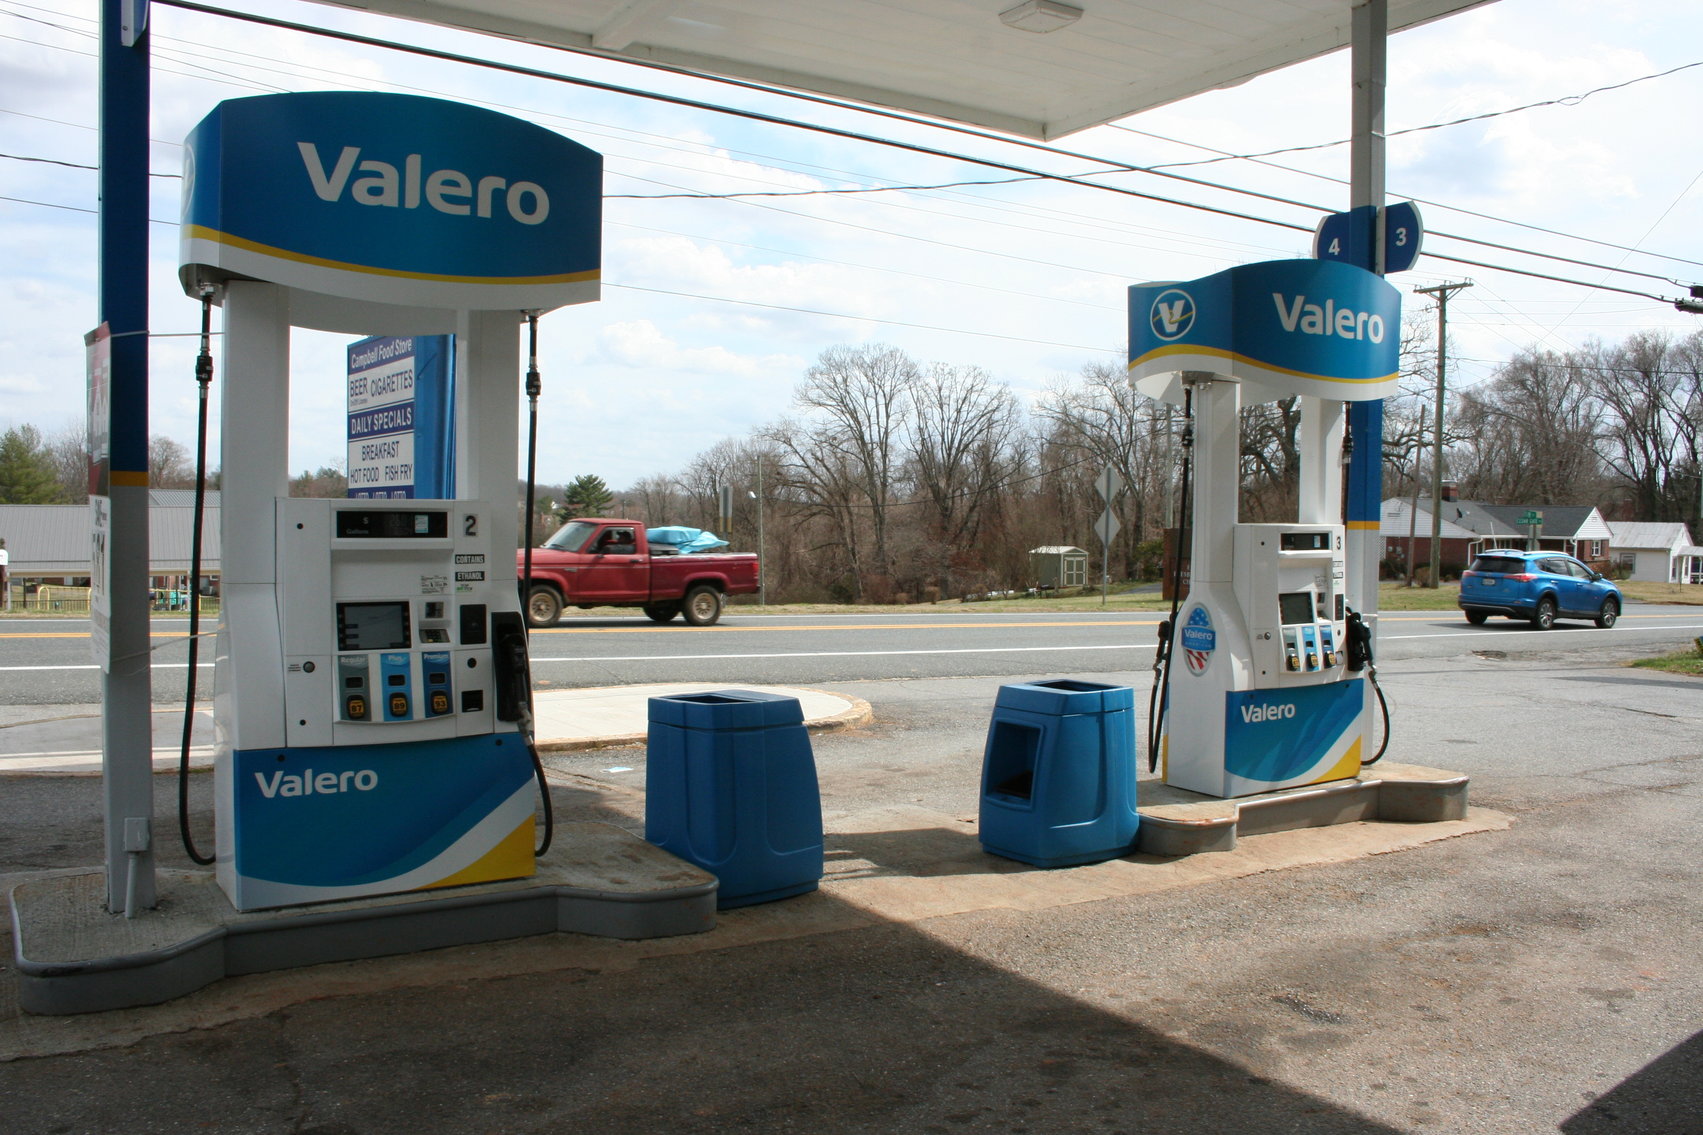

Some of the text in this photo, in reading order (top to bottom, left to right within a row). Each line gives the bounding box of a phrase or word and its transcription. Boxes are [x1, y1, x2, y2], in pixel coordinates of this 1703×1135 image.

[297, 141, 550, 226] Valero
[1328, 238, 1341, 256] 4
[1395, 227, 1407, 247] 3
[1272, 293, 1385, 344] Valero
[351, 338, 412, 369] Campbell Food Store
[350, 369, 413, 397] BEER CIGARETTES
[351, 408, 412, 434] DAILY SPECIALS
[362, 440, 400, 461] BREAKFAST
[351, 463, 413, 484] HOT FOOD FISH FRY
[465, 515, 477, 537] 2
[1336, 536, 1342, 550] 3
[456, 555, 484, 564] CONTAINS
[457, 572, 483, 581] ETHANOL
[1184, 628, 1213, 641] Valero
[351, 704, 362, 713] 87
[394, 702, 405, 710] 89
[1240, 703, 1296, 723] Valero
[254, 768, 379, 798] Valero
